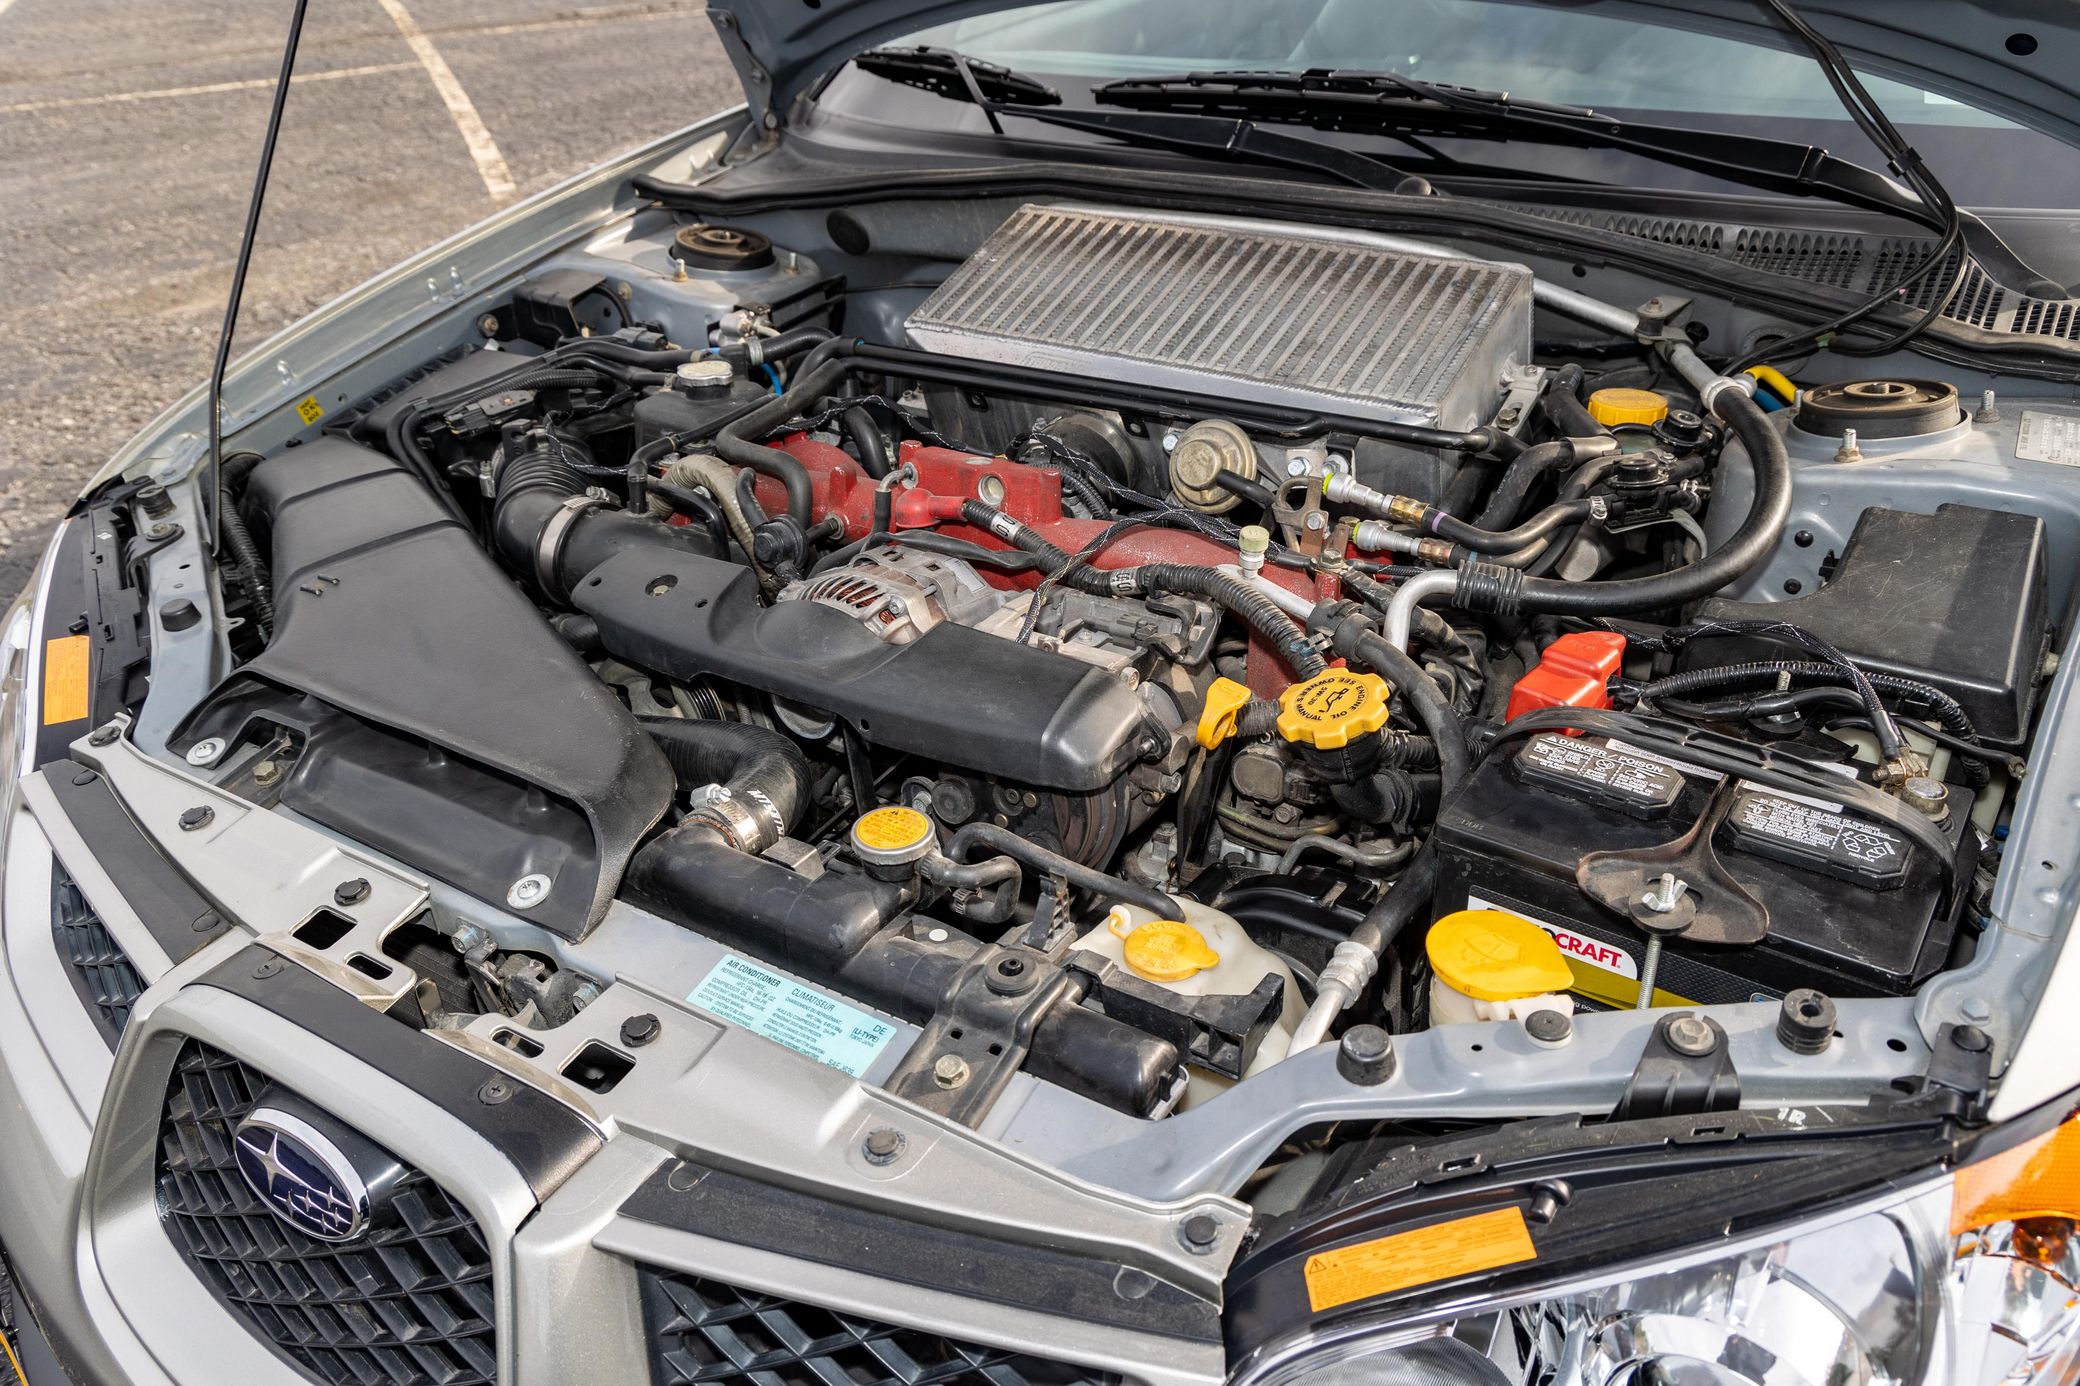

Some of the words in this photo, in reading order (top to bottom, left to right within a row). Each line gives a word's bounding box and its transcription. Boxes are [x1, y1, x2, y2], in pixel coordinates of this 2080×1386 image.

[1339, 677, 1356, 685] SEE
[1331, 711, 1348, 720] OIL
[1558, 739, 1608, 756] DANGER
[1618, 756, 1664, 772] POISON
[726, 959, 740, 969] AIR
[738, 964, 781, 987] CONDITIONER
[791, 988, 835, 1012] CLIMATISEUR
[872, 1024, 887, 1035] DE
